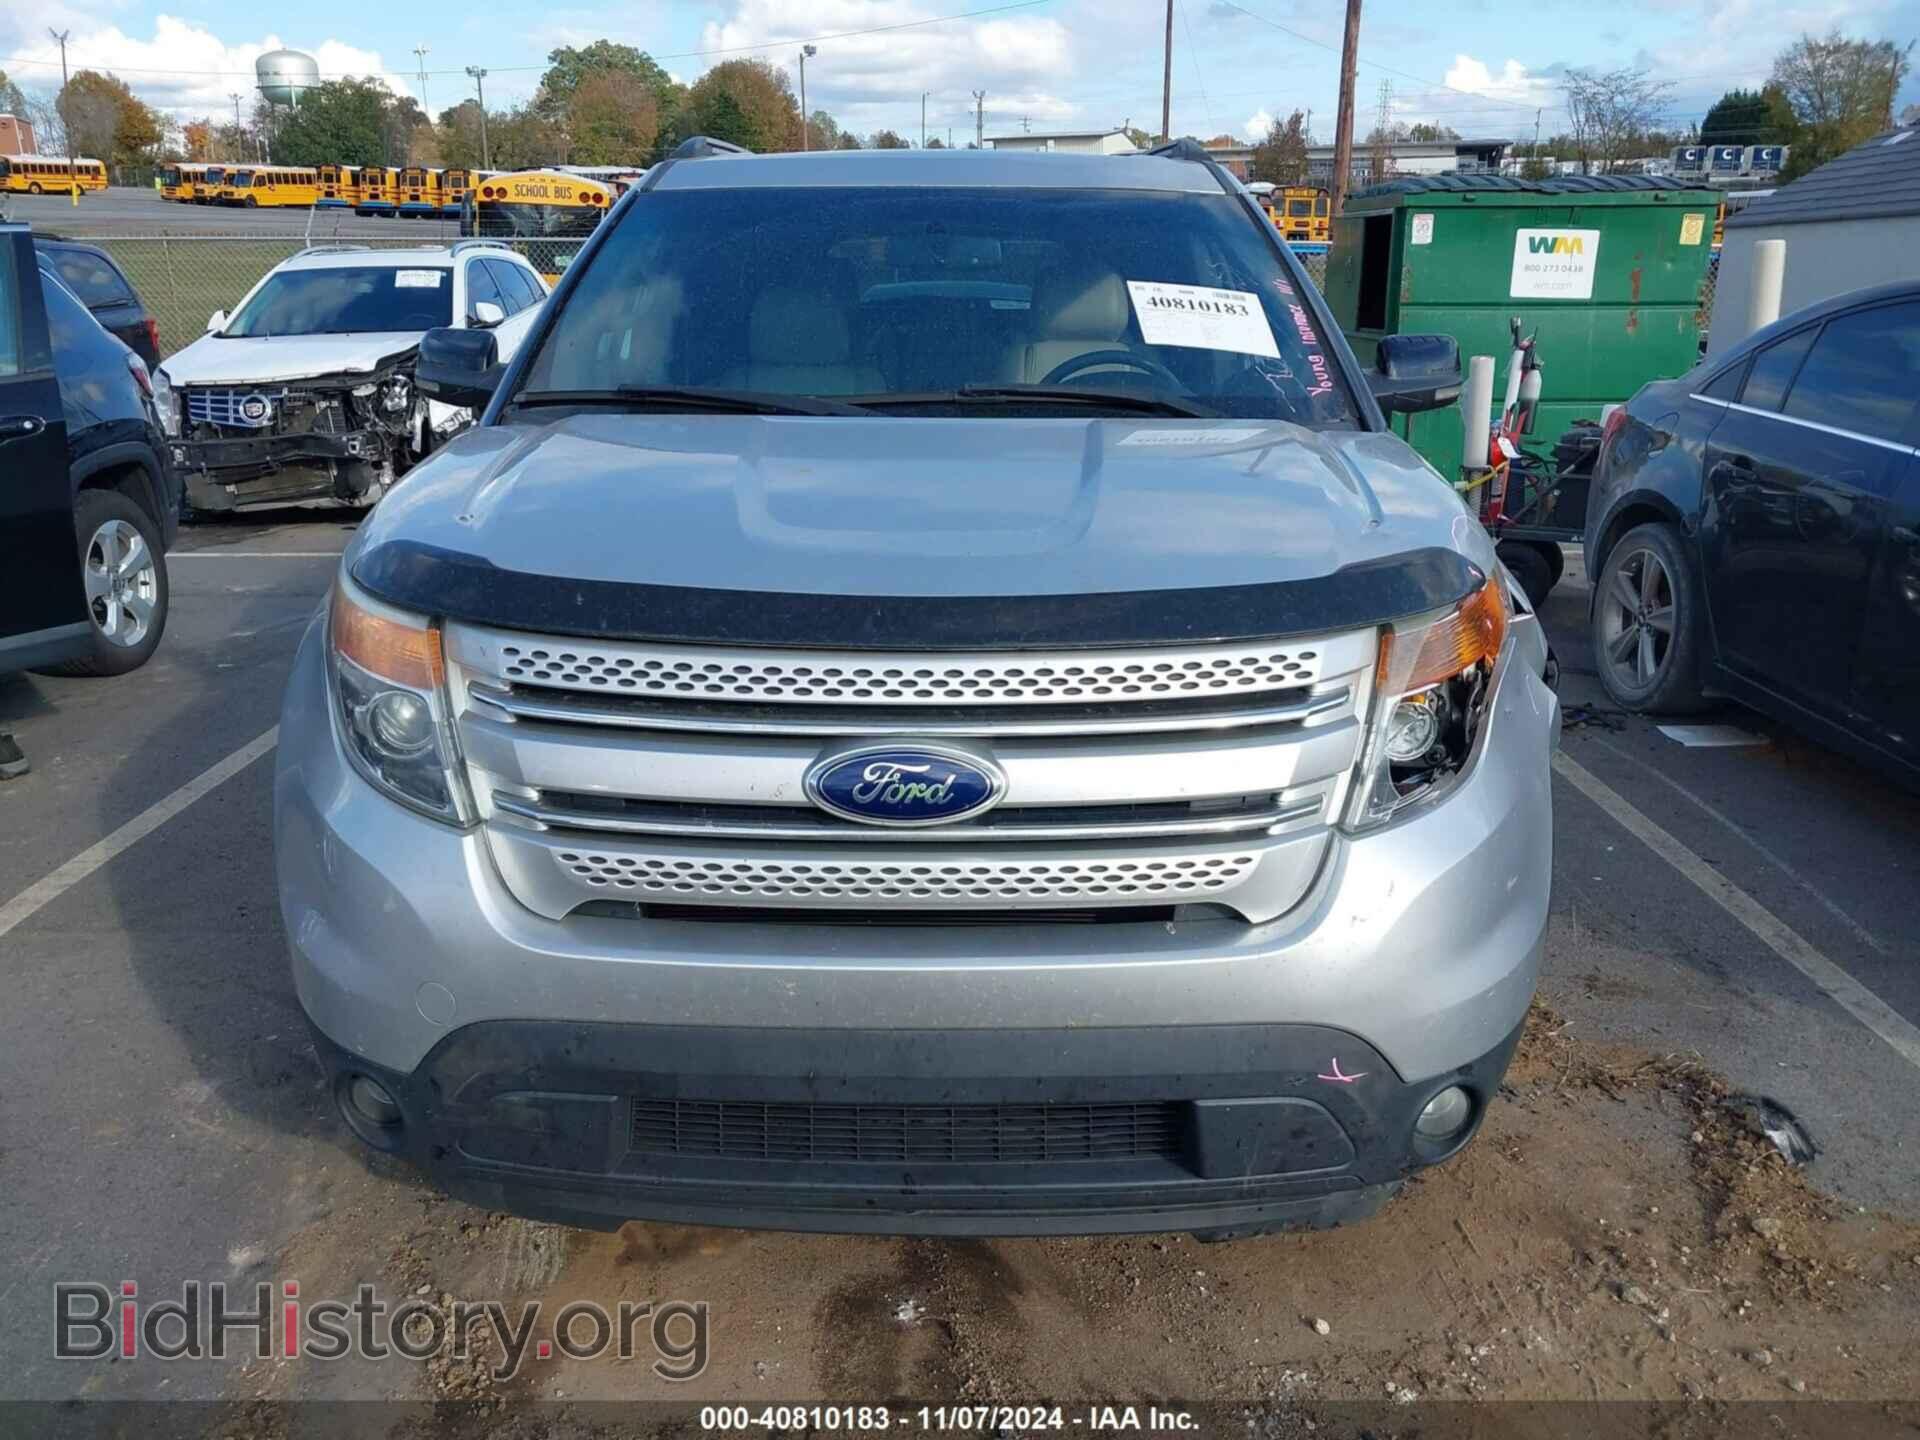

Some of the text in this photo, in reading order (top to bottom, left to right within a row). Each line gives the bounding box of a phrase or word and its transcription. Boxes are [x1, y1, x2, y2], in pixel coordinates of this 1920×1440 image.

[515, 184, 573, 200] SCHOOL BUS
[1529, 236, 1584, 255] WM
[1146, 296, 1249, 317] 40810183
[1307, 355, 1333, 396] Young
[852, 761, 956, 804] Ford
